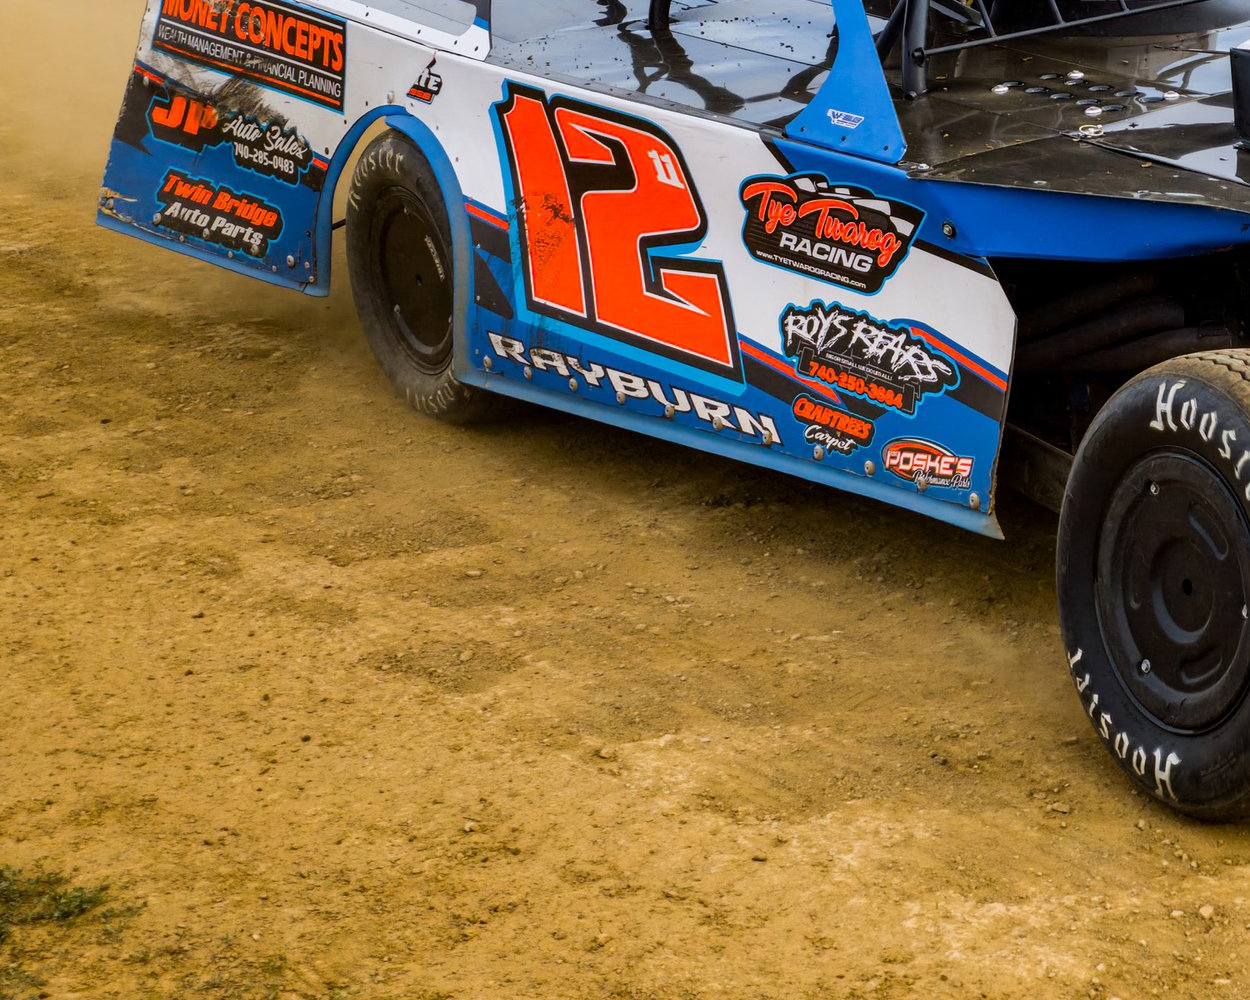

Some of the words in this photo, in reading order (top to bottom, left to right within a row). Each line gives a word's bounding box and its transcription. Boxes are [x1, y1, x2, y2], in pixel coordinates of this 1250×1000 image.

[235, 2, 344, 72] CONCEPTS
[157, 25, 188, 43] WEALTH
[187, 36, 245, 65] MANAGEMENT
[298, 71, 341, 98] PLANNING
[222, 115, 263, 142] Auto
[264, 125, 308, 160] Sales
[234, 142, 294, 174] 740-285-0483
[647, 148, 687, 189] 11
[163, 174, 213, 205] Twin
[212, 191, 278, 227] Bridge
[165, 202, 210, 229] Auto
[210, 215, 264, 246] Parts
[502, 92, 736, 370] 12
[743, 182, 798, 233] Tye
[798, 199, 902, 267] Twarog
[779, 231, 873, 273] RACING
[487, 331, 783, 445] RAYBURN
[793, 397, 873, 440] CRABTREES
[804, 424, 857, 451] Carpet
[885, 450, 973, 477] POSKE'S
[1067, 648, 1181, 801] Hoosier
